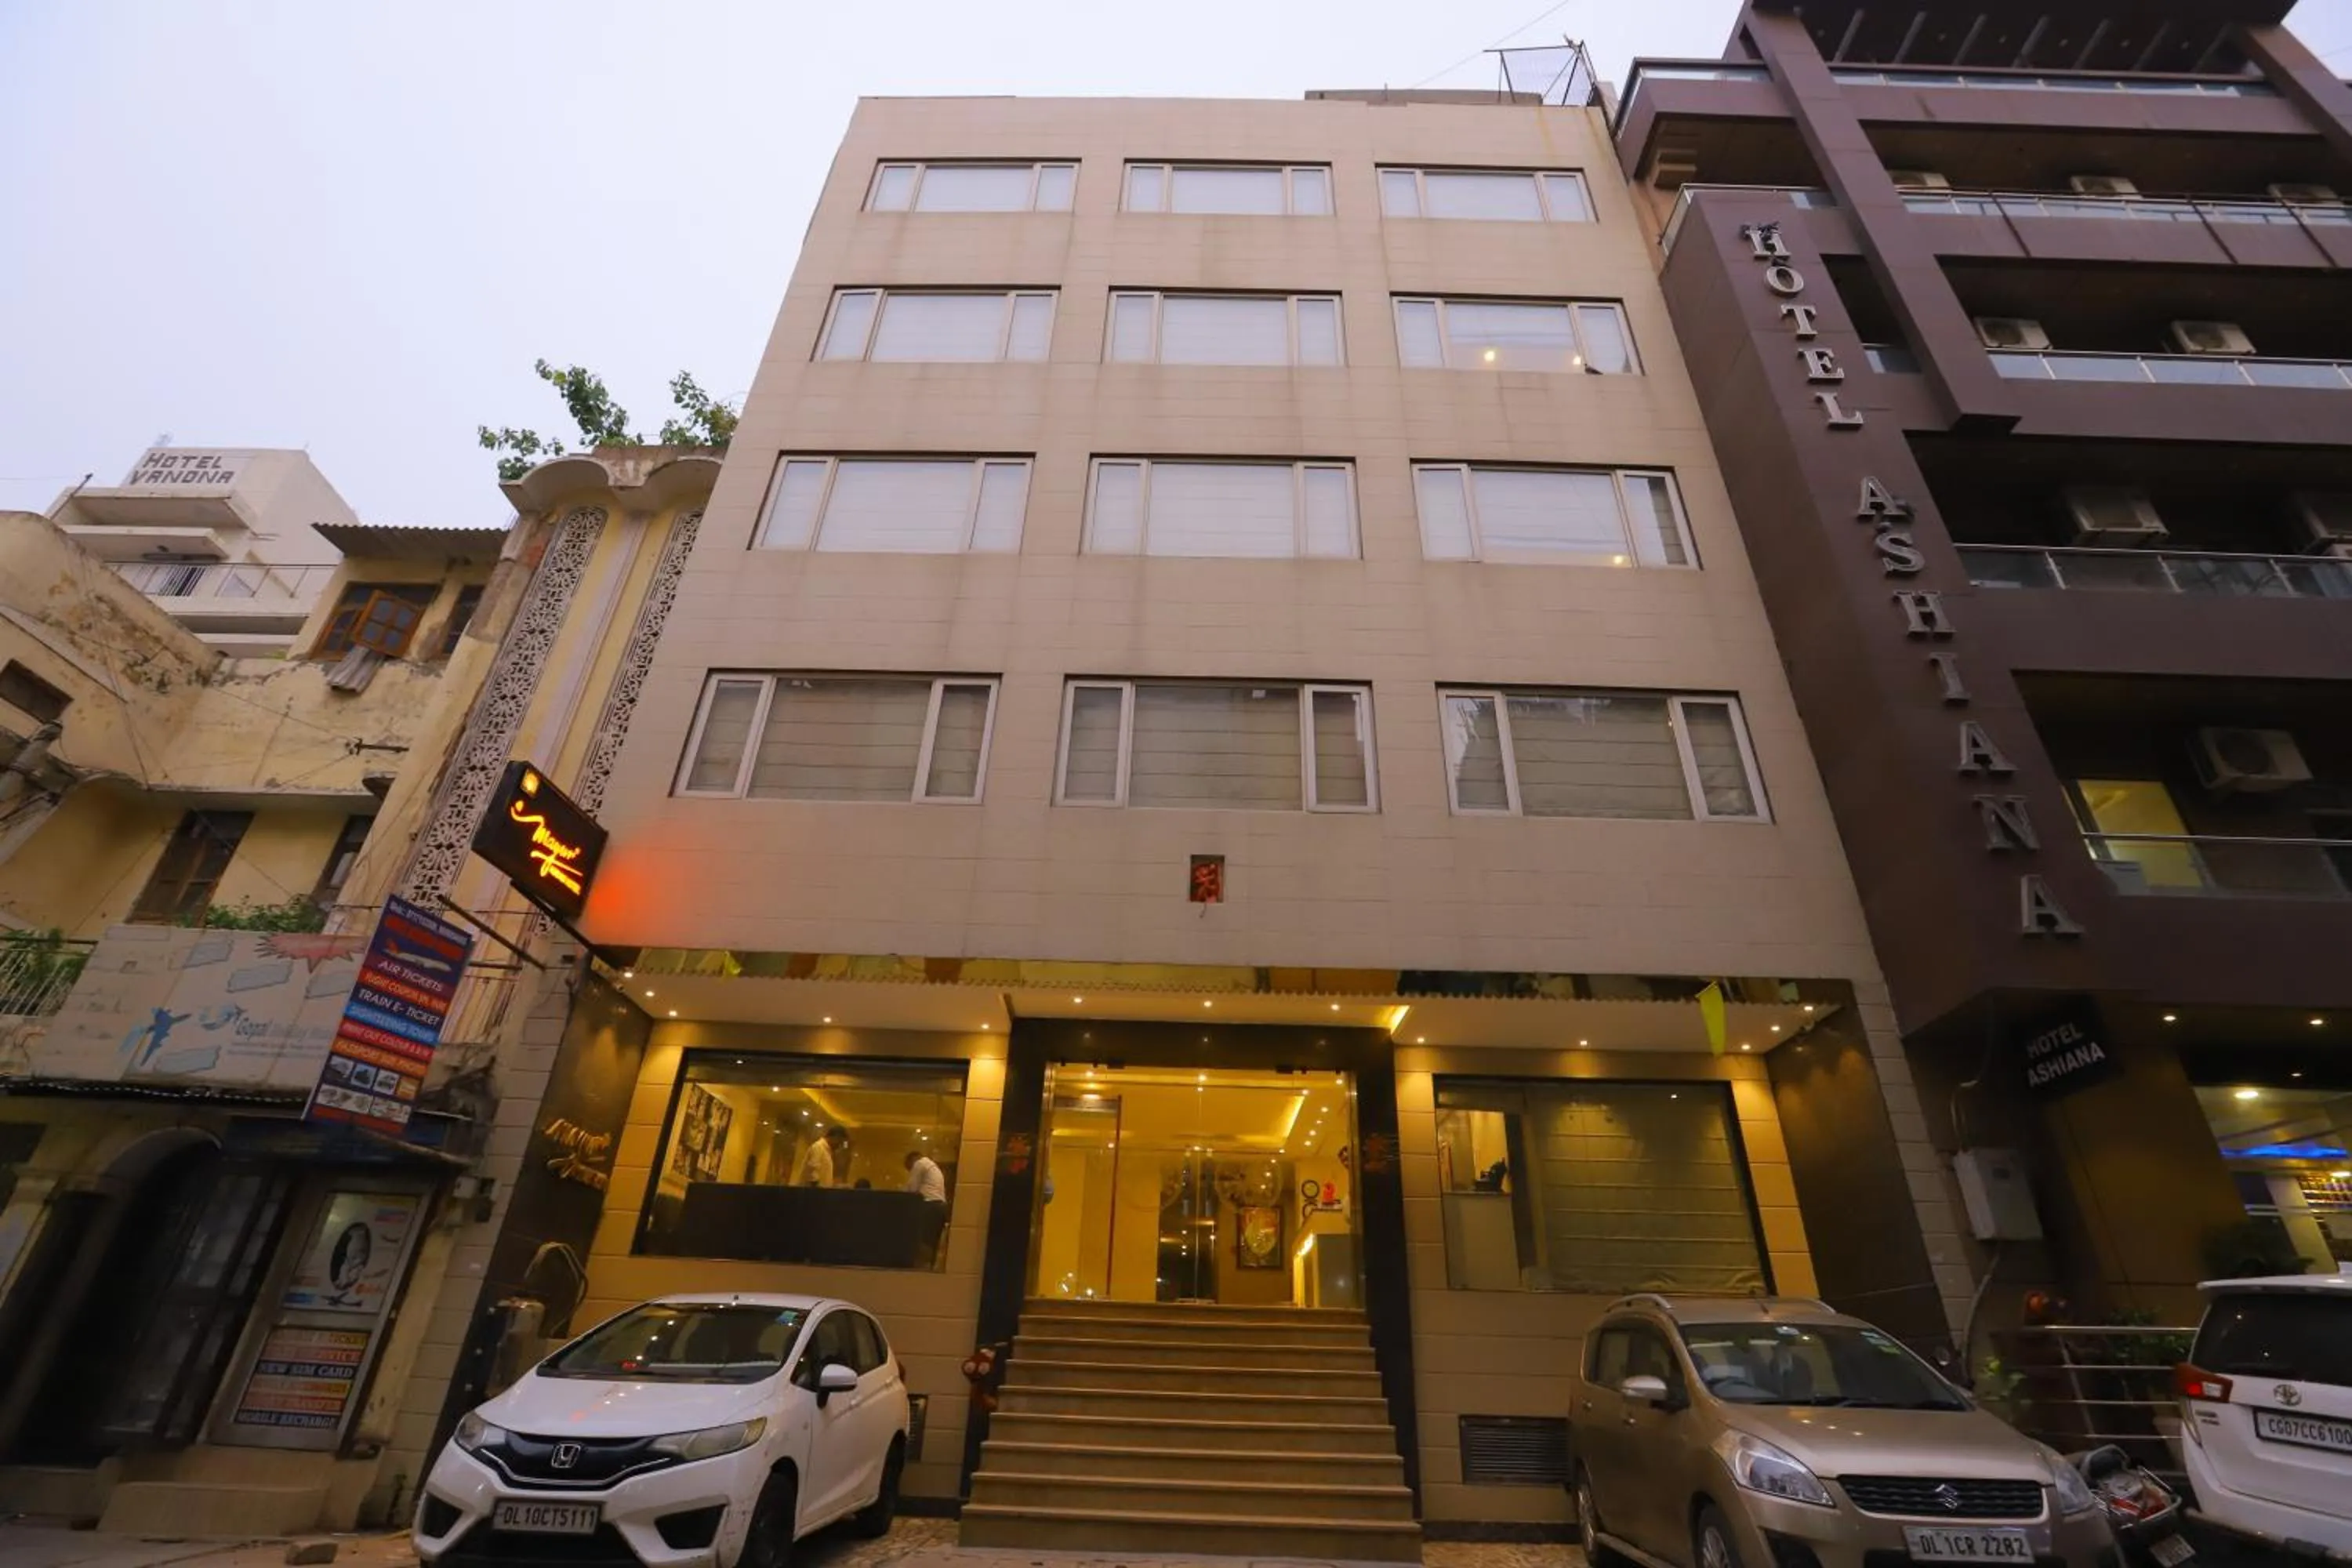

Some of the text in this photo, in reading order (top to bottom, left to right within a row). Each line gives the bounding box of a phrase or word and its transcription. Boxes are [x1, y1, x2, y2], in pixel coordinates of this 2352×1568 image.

[143, 452, 223, 469] HOTEL
[129, 470, 235, 485] VANDNA
[1744, 225, 2085, 935] HOTEL ASHIANA
[358, 989, 393, 1011] TRAIN
[406, 1006, 440, 1026] TICKET
[2027, 1022, 2085, 1059] HOTEL
[2027, 1041, 2107, 1088] ASHIANA
[318, 1365, 354, 1378] CARD
[1920, 1534, 1943, 1555] DL
[1981, 1537, 2029, 1558] 2282
